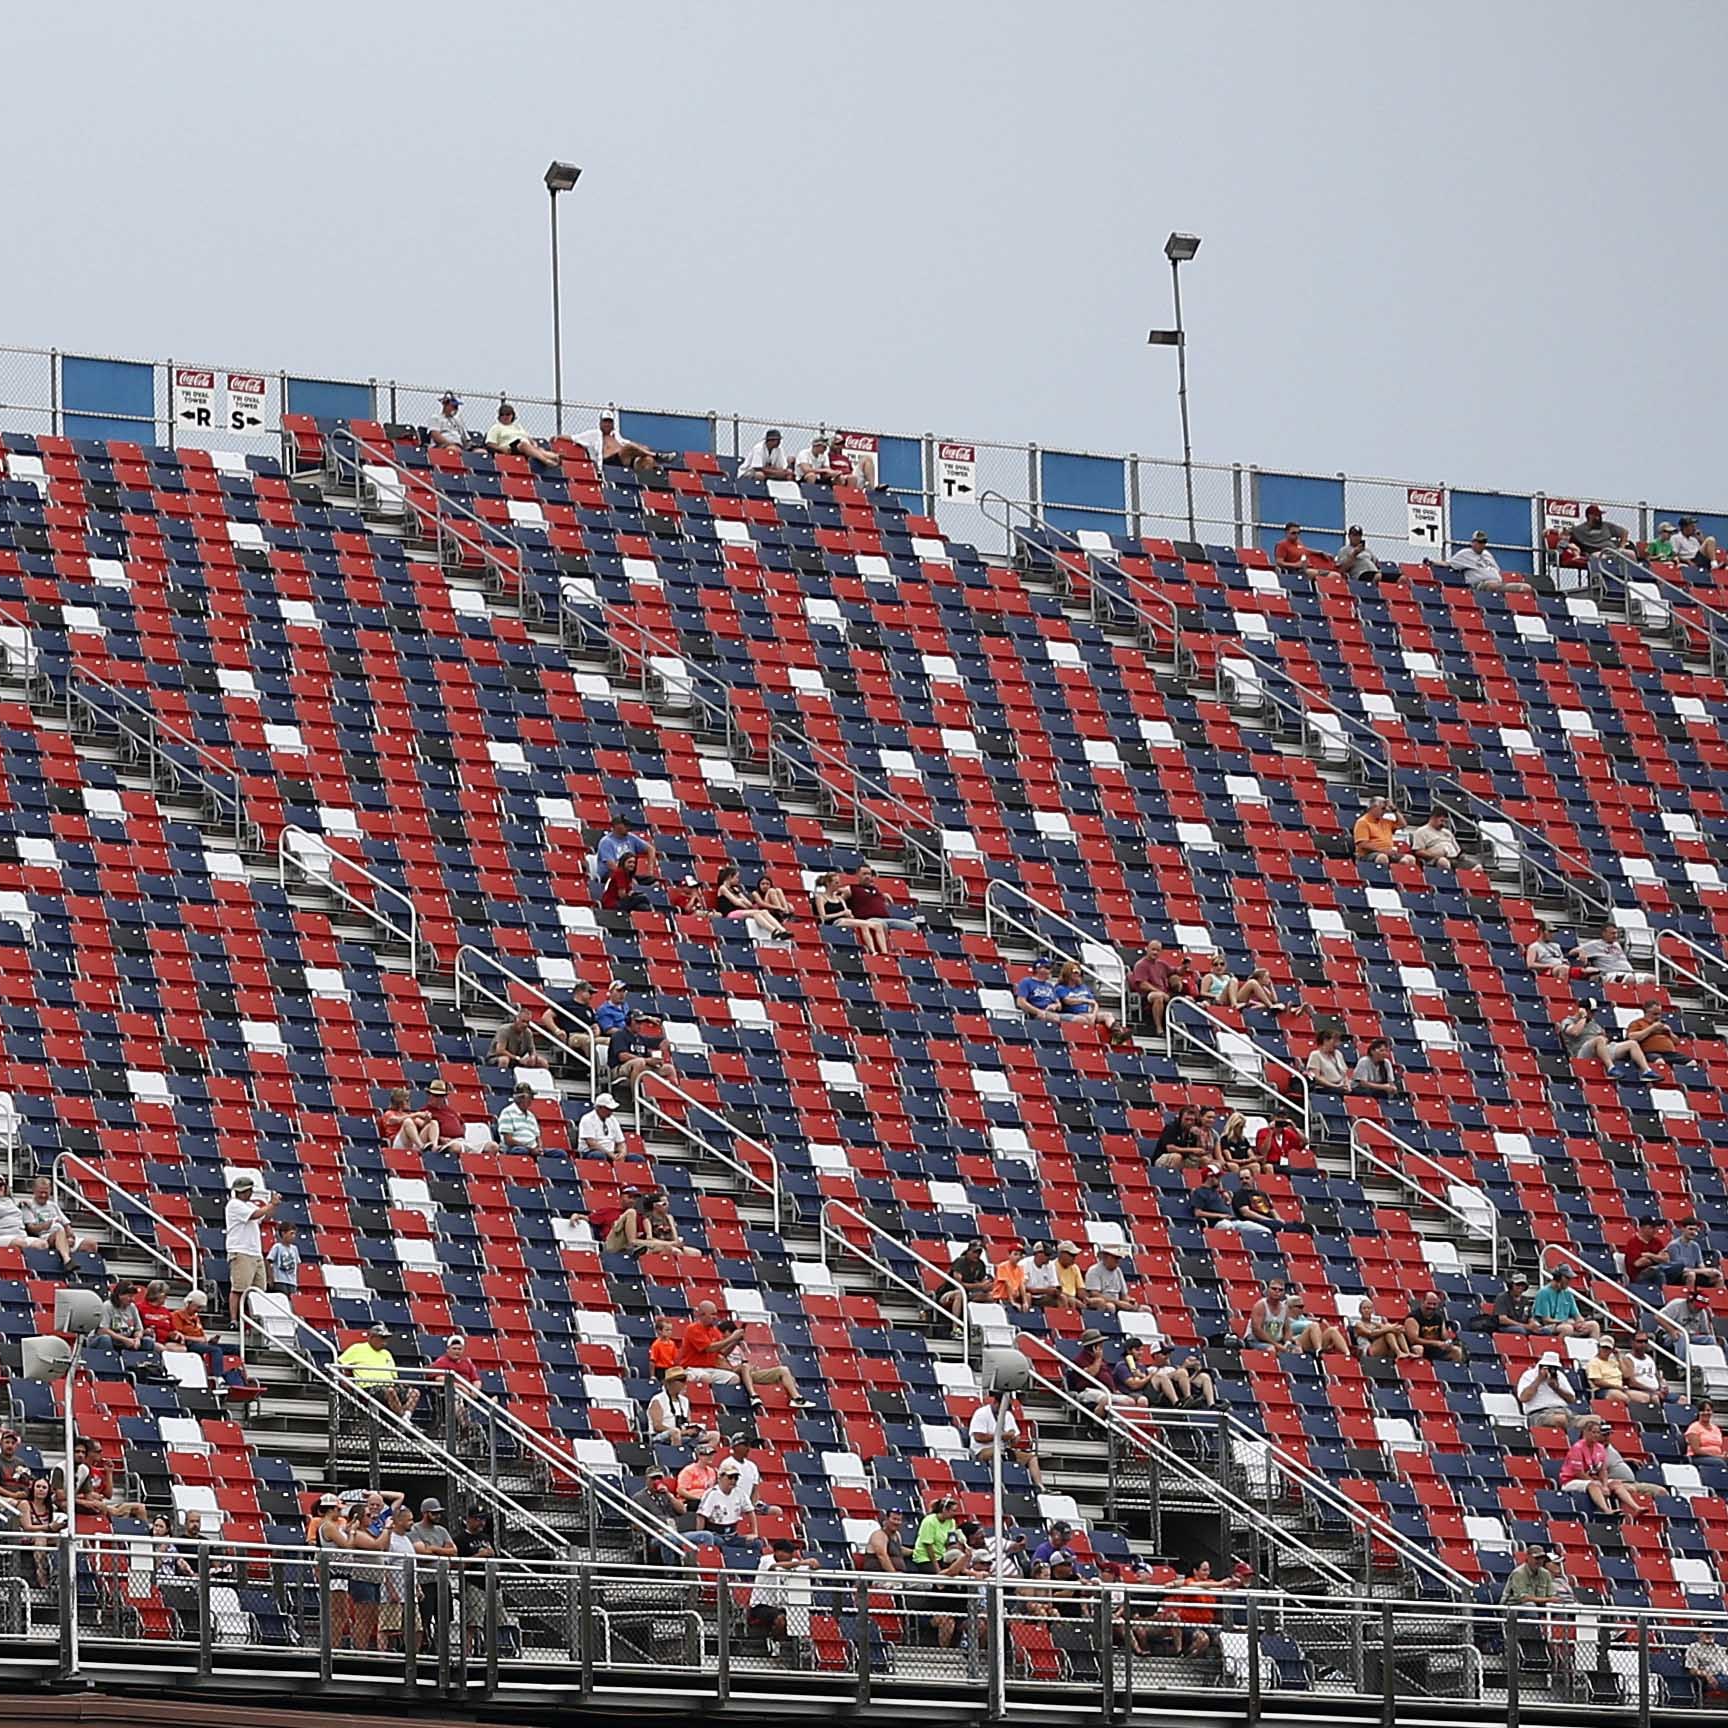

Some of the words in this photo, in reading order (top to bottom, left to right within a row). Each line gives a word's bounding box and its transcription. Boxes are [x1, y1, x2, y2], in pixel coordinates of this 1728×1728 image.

[235, 402, 258, 410] TOWER
[197, 408, 211, 426] R
[231, 411, 245, 430] S
[943, 479, 956, 496] T
[1426, 525, 1438, 542] T
